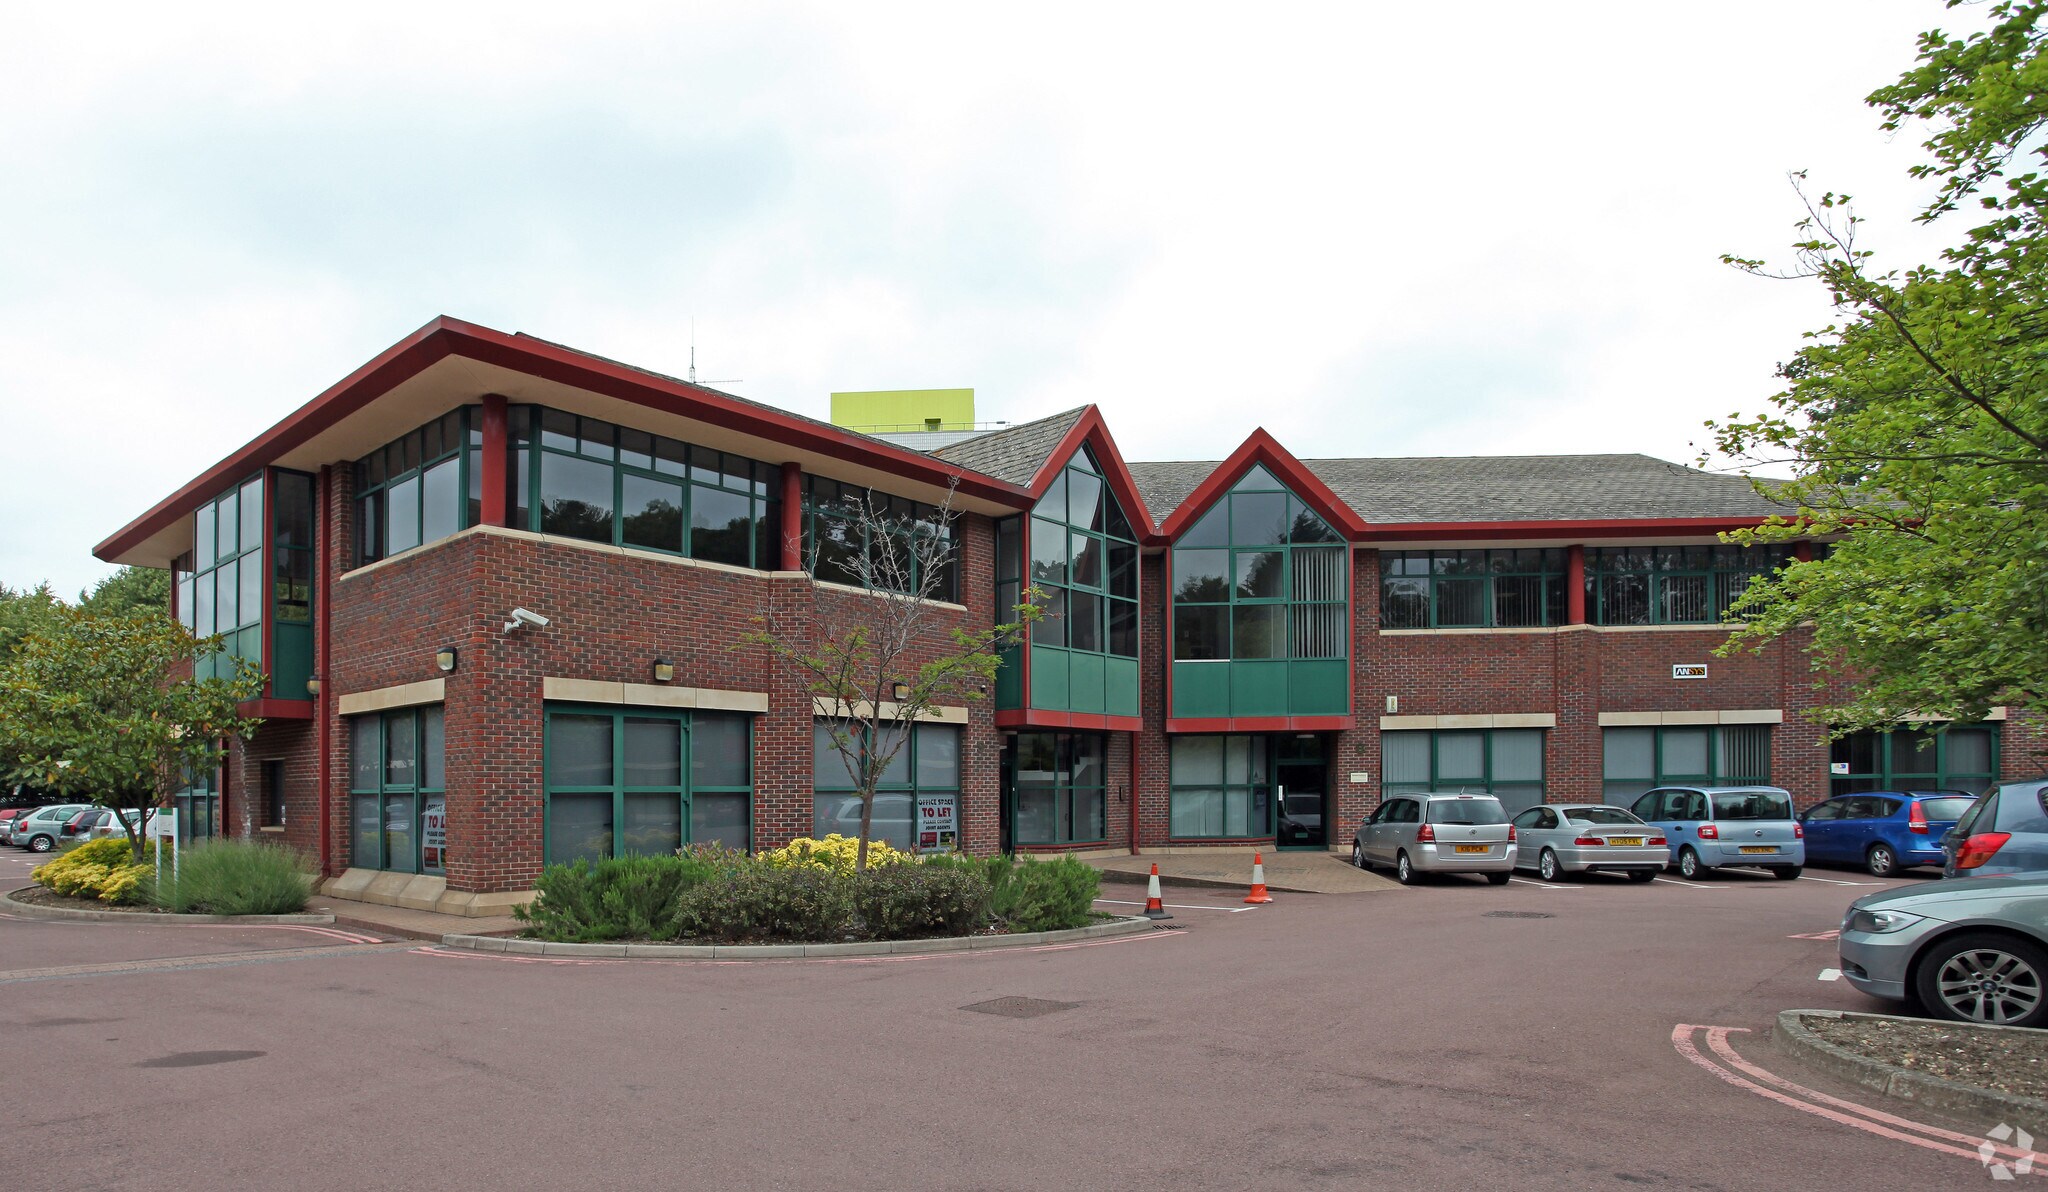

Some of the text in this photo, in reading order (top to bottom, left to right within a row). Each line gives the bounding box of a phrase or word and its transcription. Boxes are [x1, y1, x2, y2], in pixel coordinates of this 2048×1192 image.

[922, 808, 951, 817] TO LET
[428, 816, 438, 828] TO
